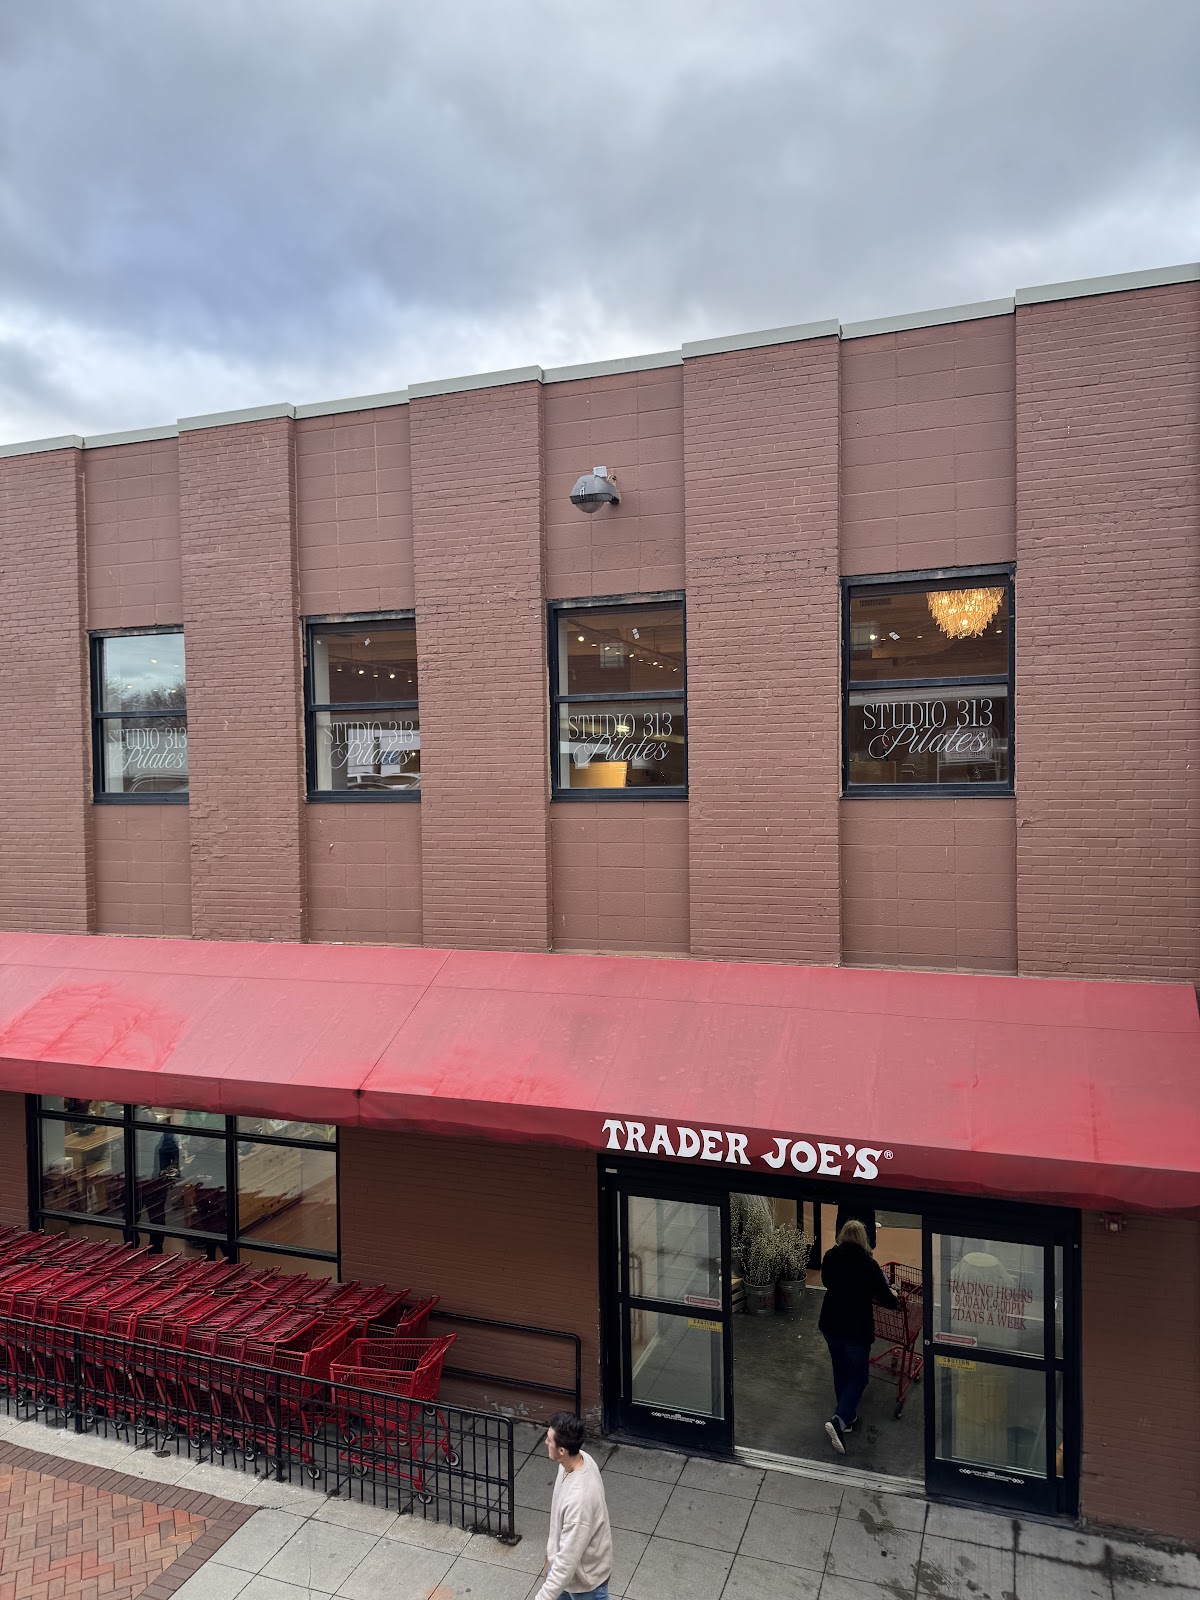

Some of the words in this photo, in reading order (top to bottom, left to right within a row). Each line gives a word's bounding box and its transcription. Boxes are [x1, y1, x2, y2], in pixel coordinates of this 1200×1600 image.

[568, 713, 636, 739] STUDIO
[642, 711, 673, 738] 313
[863, 700, 947, 730] STUDIO
[956, 698, 993, 728] 313
[108, 728, 160, 750] STUDIO
[164, 726, 188, 749] 313
[323, 721, 382, 745] STUDIO
[388, 720, 414, 744] 313
[868, 721, 990, 759] Pilates
[113, 744, 186, 772] Pilates
[328, 738, 412, 769] Pilates
[572, 732, 670, 766] Pilates
[601, 1119, 751, 1165] TRADER
[946, 1278, 993, 1299] TRADING
[996, 1286, 1033, 1304] HOURS
[693, 1319, 717, 1327] CAUTION
[987, 1312, 994, 1326] A
[997, 1314, 1027, 1331] WEEK
[943, 1357, 970, 1366] CAUTION
